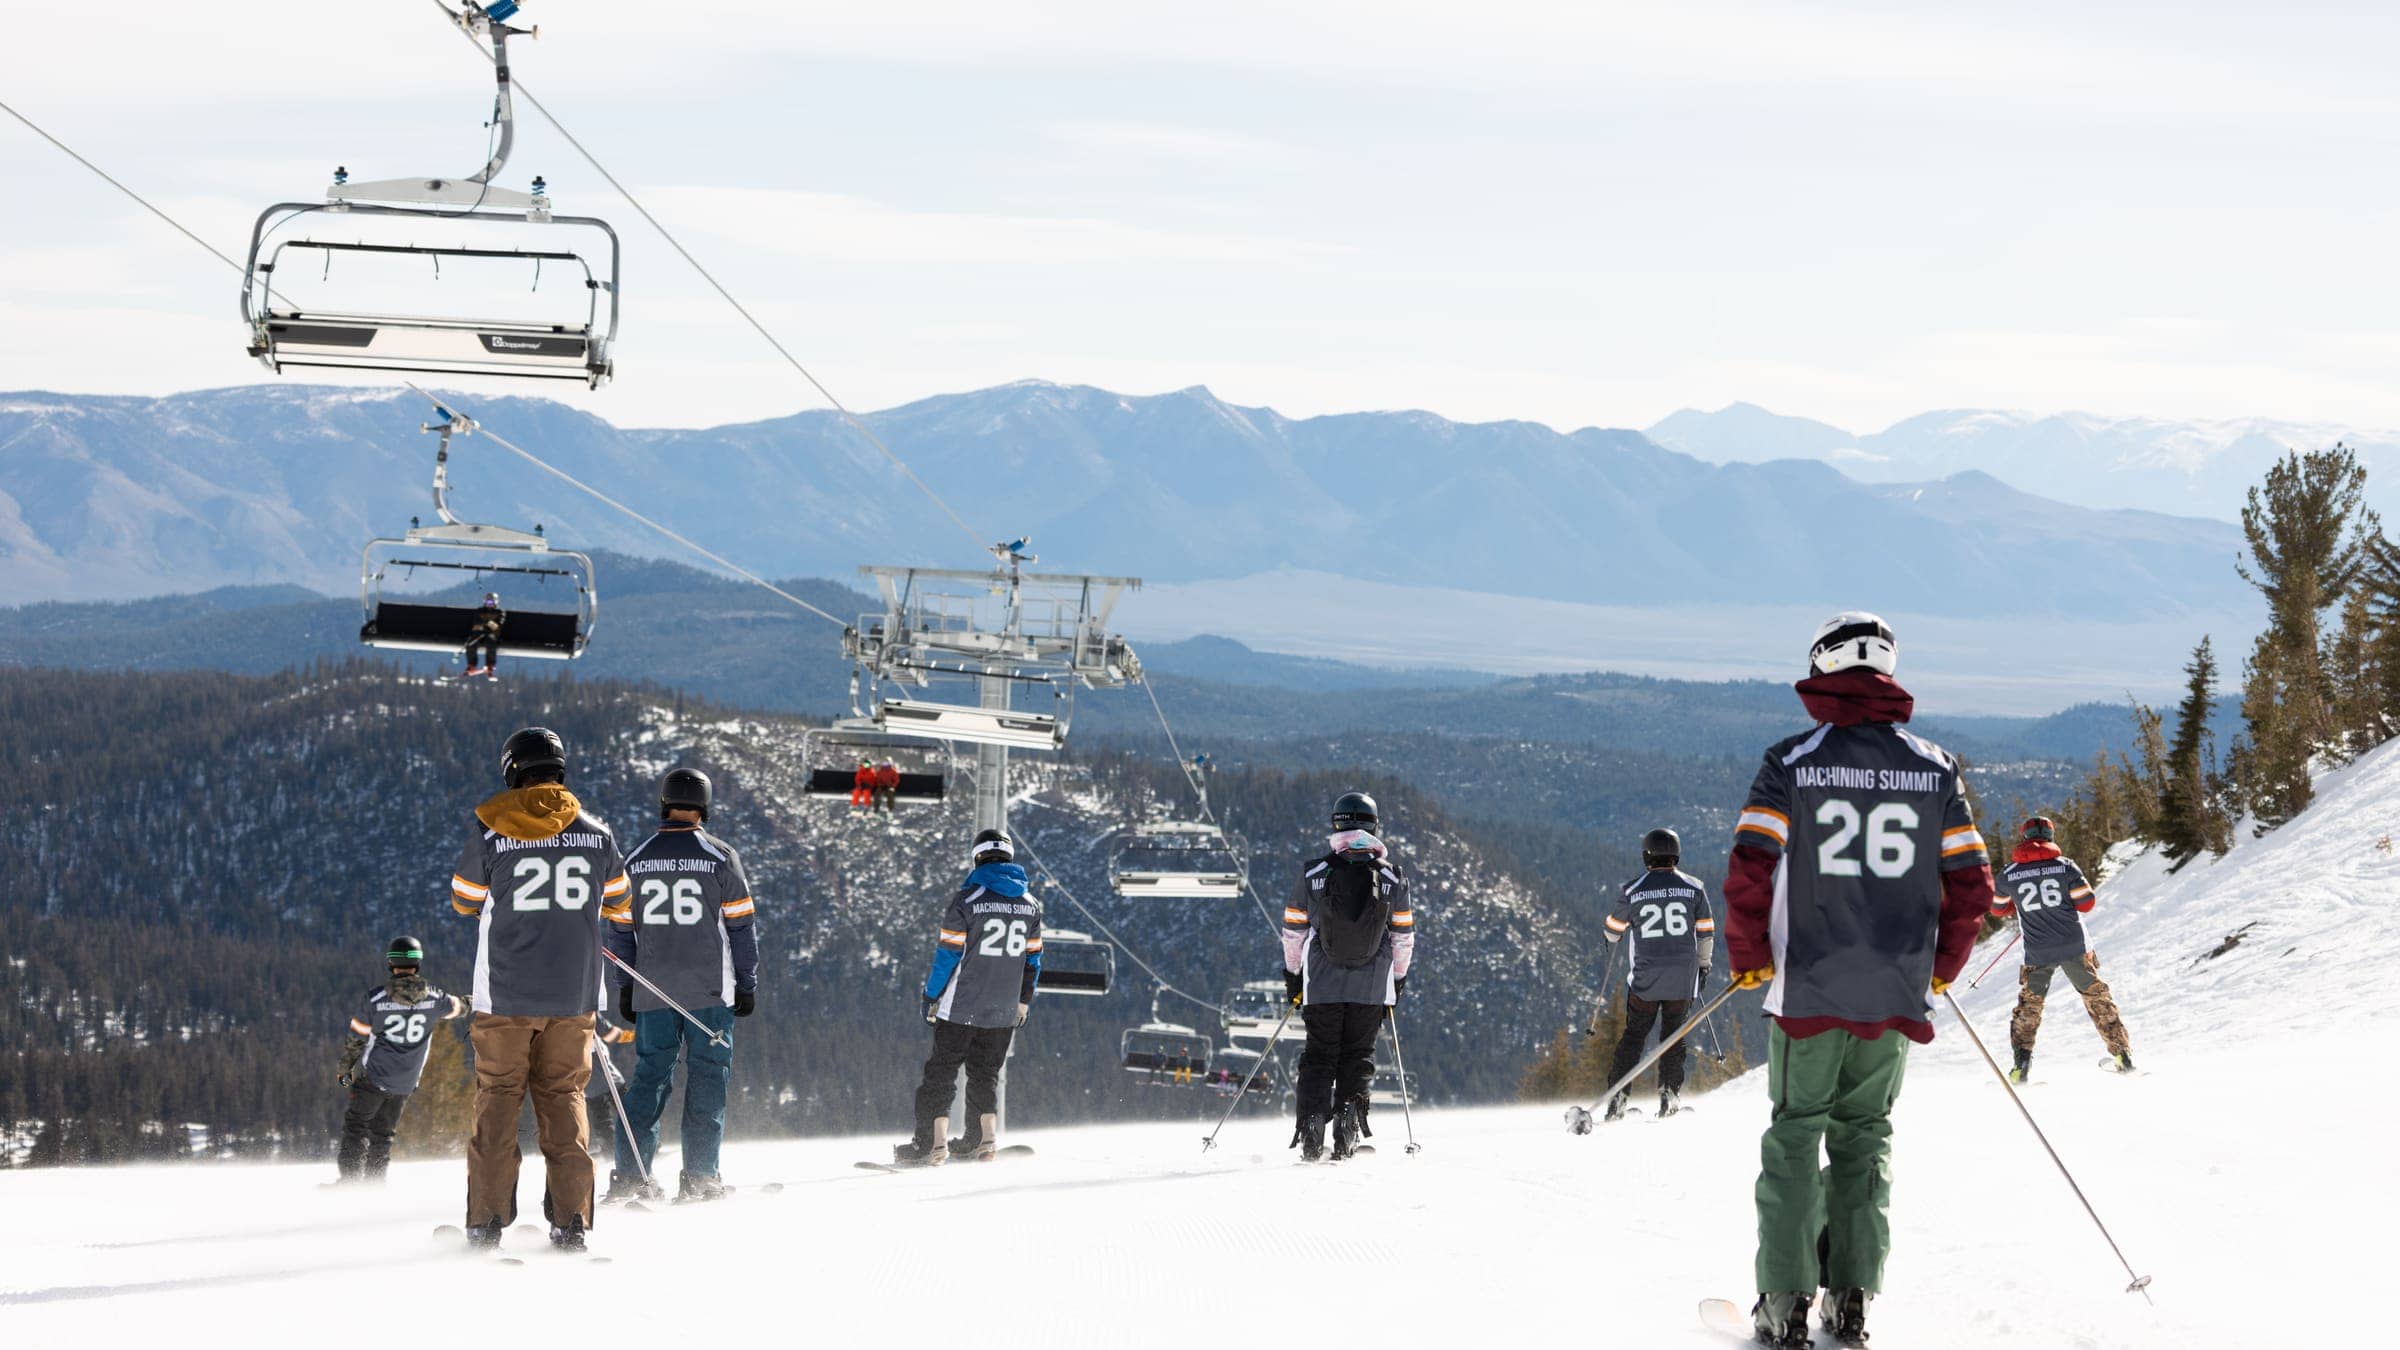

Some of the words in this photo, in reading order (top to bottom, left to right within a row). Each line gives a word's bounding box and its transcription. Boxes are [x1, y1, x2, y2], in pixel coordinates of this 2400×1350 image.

[1795, 766, 1875, 790] MACHINING
[1879, 770, 1942, 792] SUMMIT
[562, 832, 603, 849] SUMMIT
[1815, 798, 1920, 879] 26
[513, 855, 591, 911] 26
[678, 858, 717, 873] SUMMIT
[640, 878, 703, 925] 26
[972, 902, 1012, 914] MACHINING
[2017, 878, 2063, 913] 26
[979, 918, 1028, 957] 26
[1639, 901, 1688, 939] 26
[384, 1013, 427, 1044] 26
